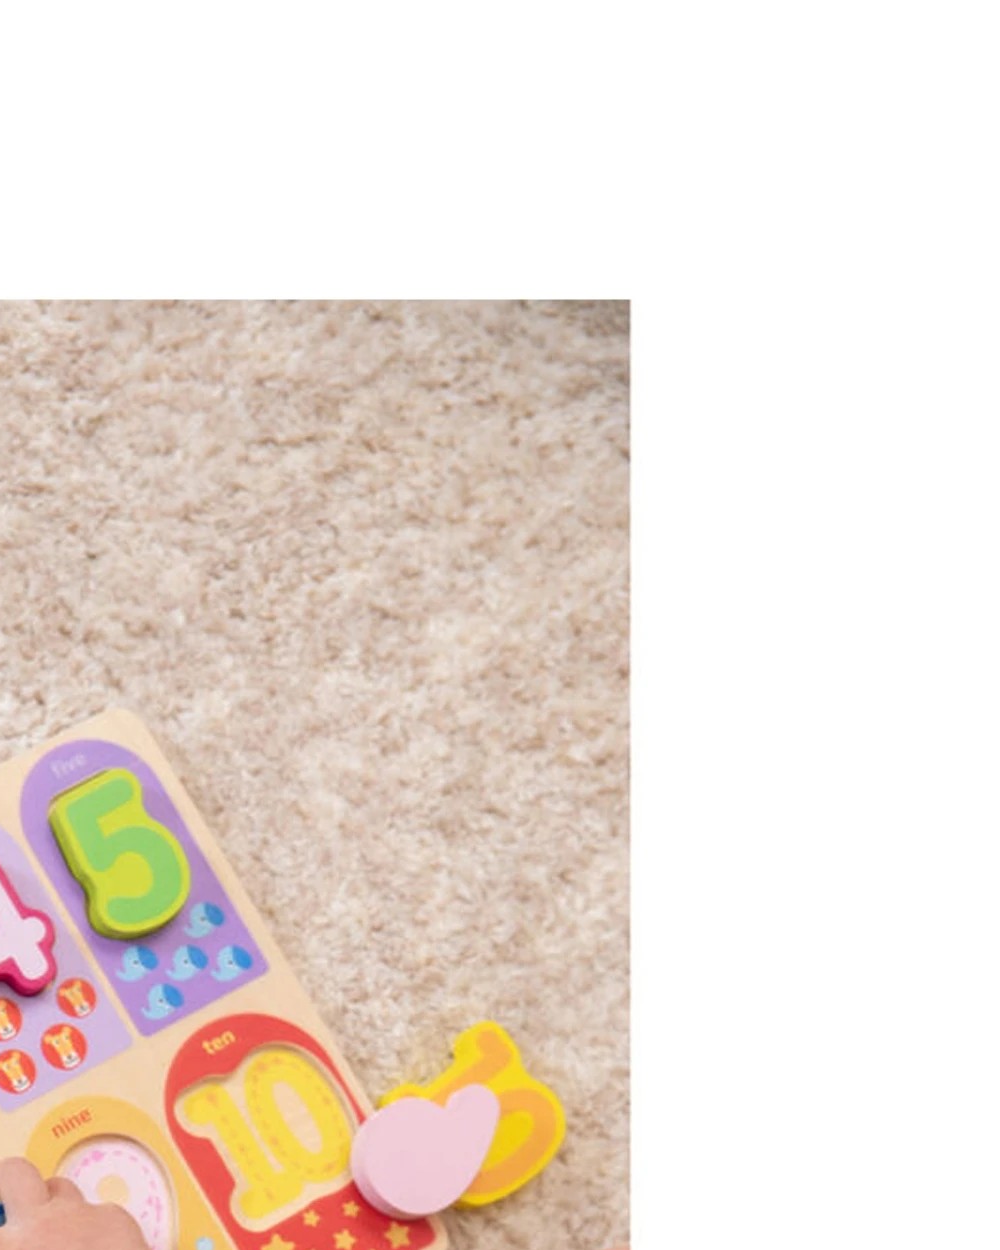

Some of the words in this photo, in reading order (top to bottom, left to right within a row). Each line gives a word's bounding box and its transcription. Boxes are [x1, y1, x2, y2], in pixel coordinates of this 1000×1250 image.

[52, 751, 89, 779] five
[60, 770, 188, 930] 5
[203, 1030, 235, 1055] ten
[51, 1107, 92, 1139] nine
[181, 1048, 353, 1221] 10
